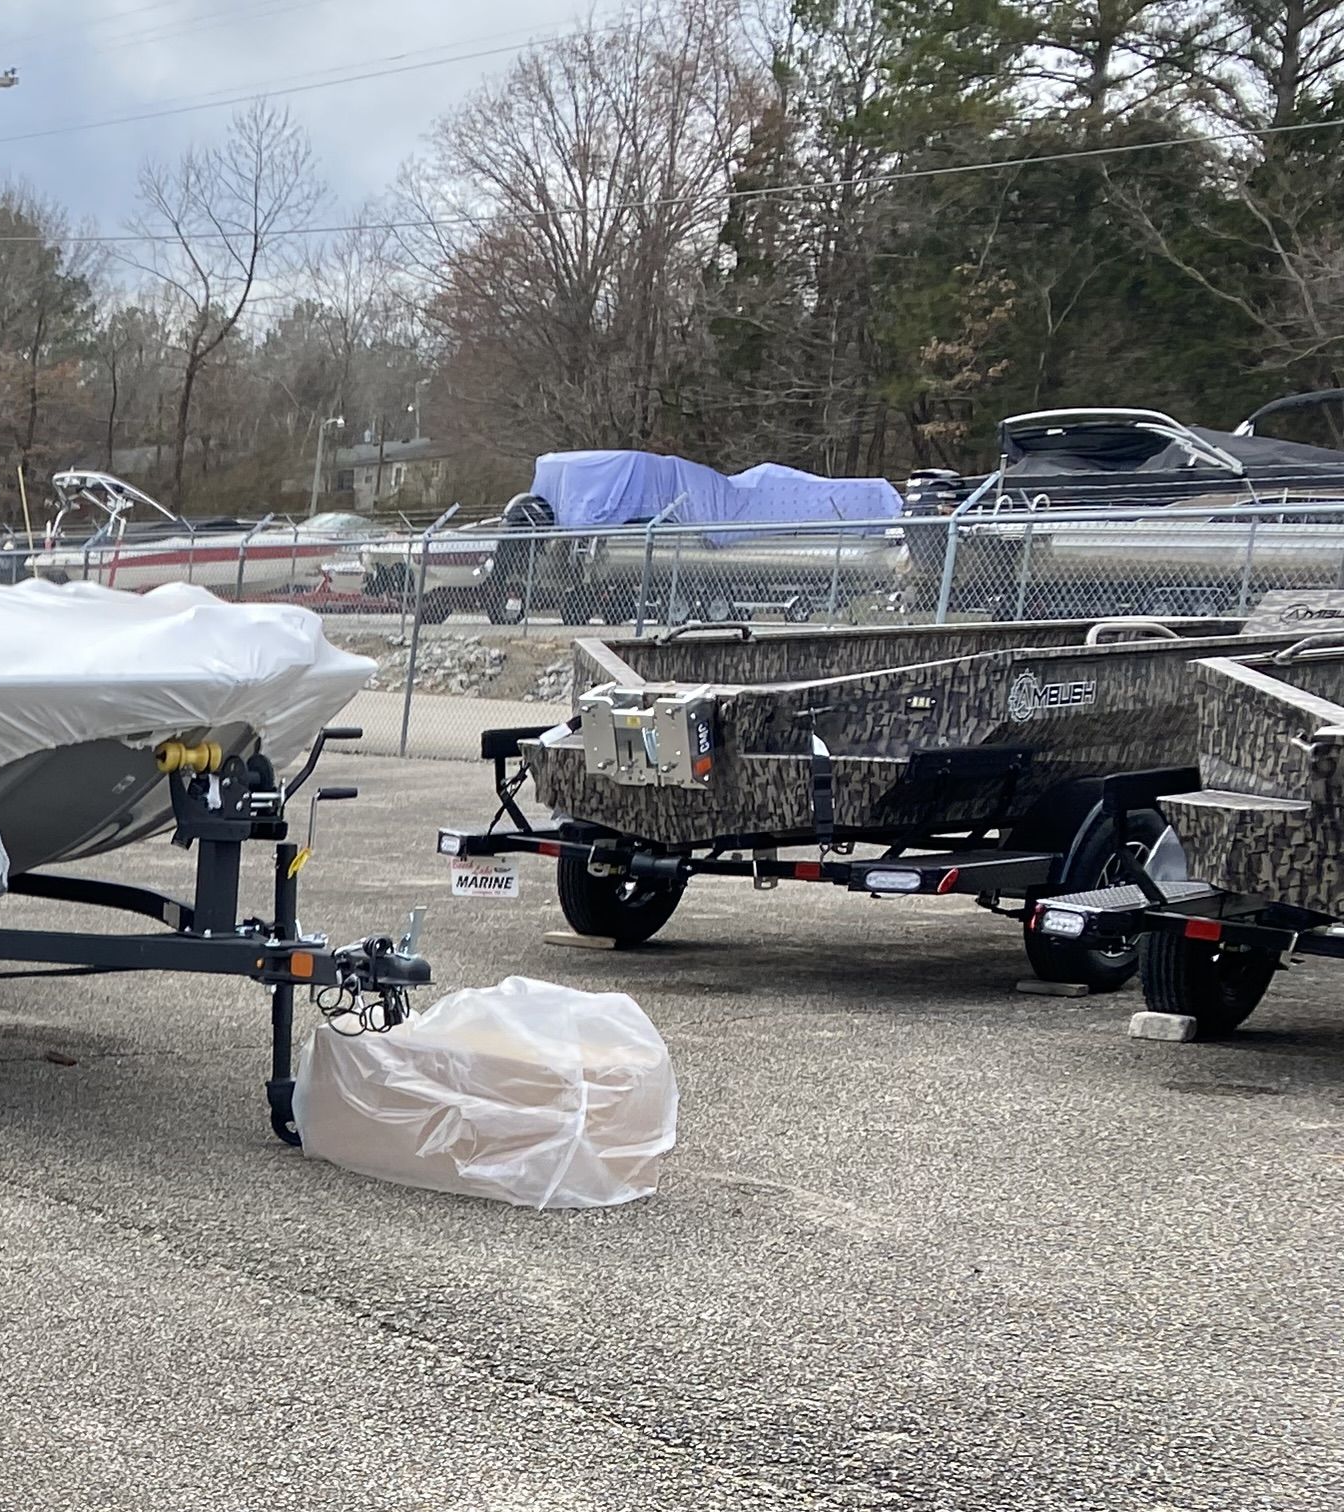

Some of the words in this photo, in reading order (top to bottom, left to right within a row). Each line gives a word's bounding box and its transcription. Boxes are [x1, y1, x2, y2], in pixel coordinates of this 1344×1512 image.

[1015, 680, 1096, 711] AMBUSH
[697, 723, 710, 753] CMC
[456, 876, 514, 890] MARINE
